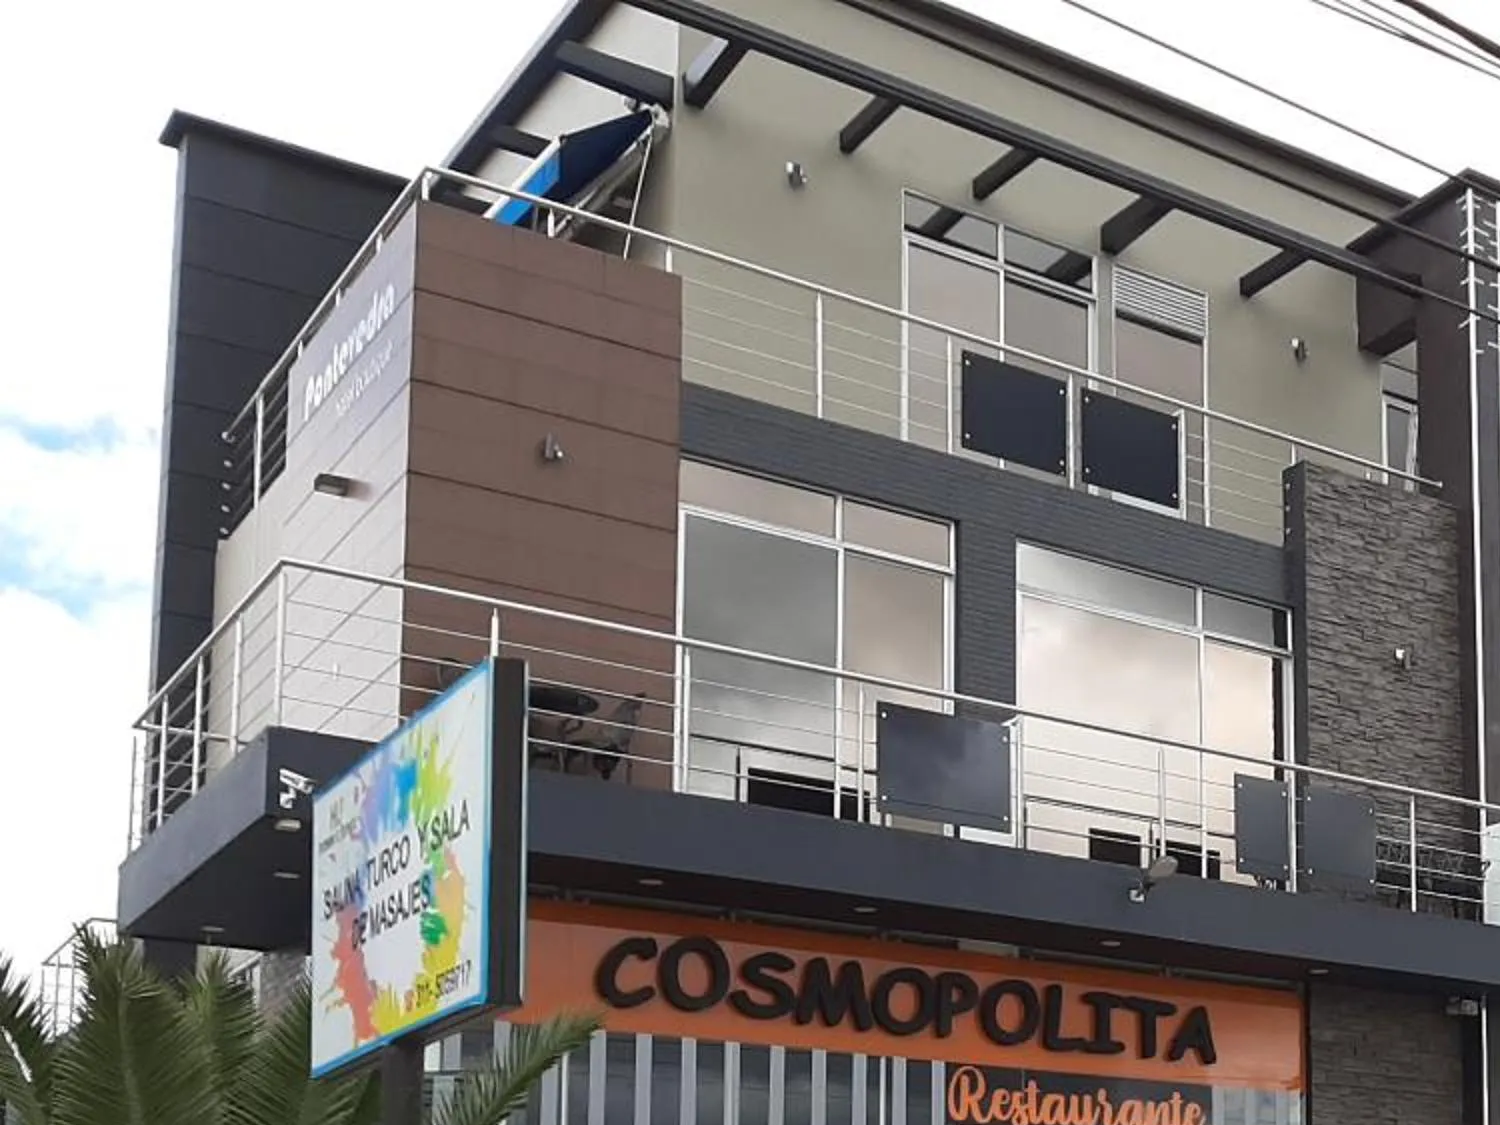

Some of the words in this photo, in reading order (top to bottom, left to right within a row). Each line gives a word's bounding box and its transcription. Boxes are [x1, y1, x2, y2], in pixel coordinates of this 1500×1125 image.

[366, 835, 411, 891] TURCO
[418, 822, 428, 858] Y
[430, 799, 471, 851] SALA
[352, 911, 368, 949] DE
[369, 874, 431, 938] MASAJES
[594, 935, 1218, 1066] COSMOPOLITA
